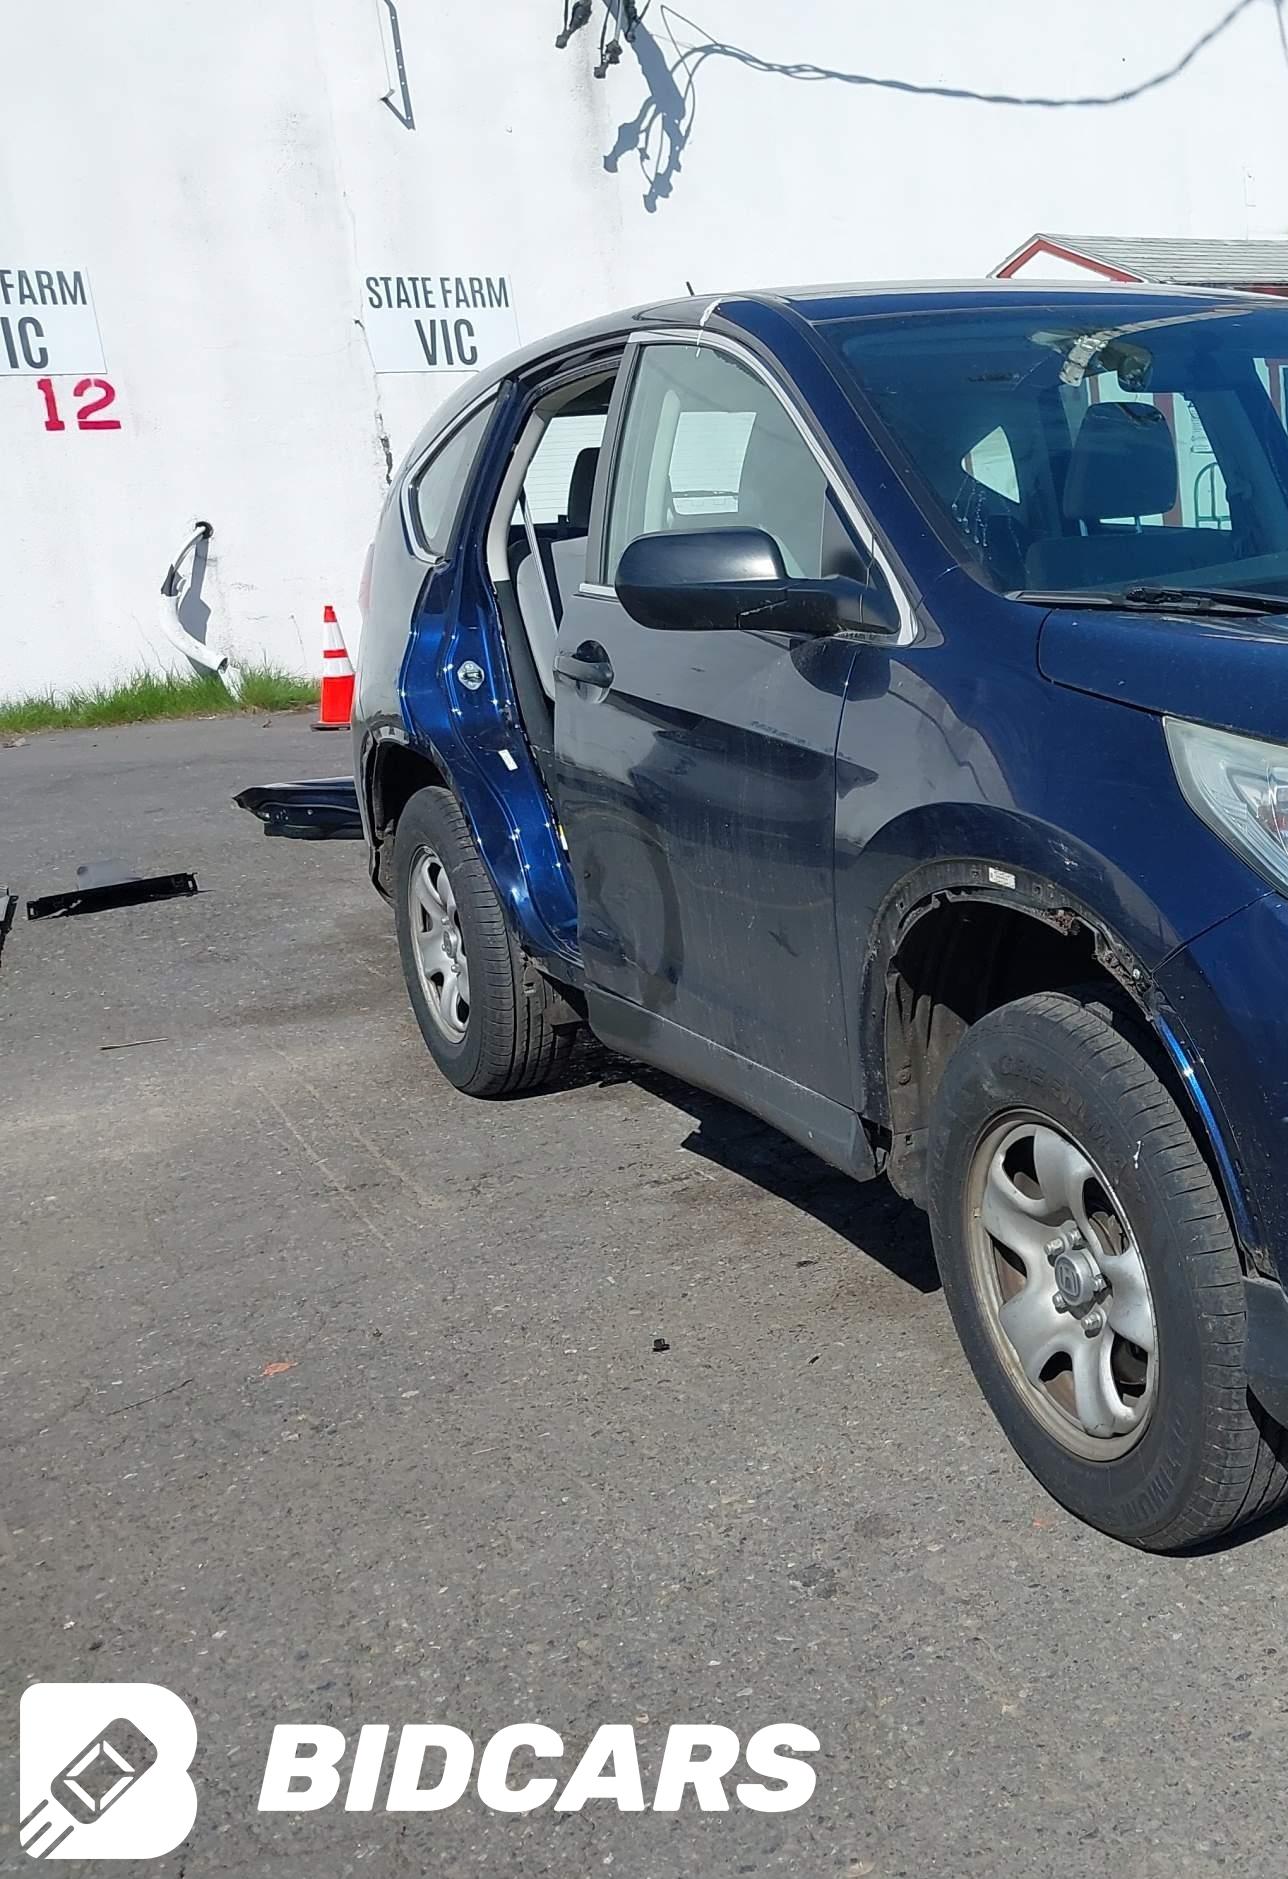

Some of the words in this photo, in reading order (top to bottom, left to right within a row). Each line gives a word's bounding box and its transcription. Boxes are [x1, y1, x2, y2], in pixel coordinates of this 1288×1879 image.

[0, 269, 87, 305] FARM
[365, 276, 436, 309] STATE
[440, 276, 509, 309] FARM
[414, 318, 478, 366] VIC
[37, 378, 121, 432] 12
